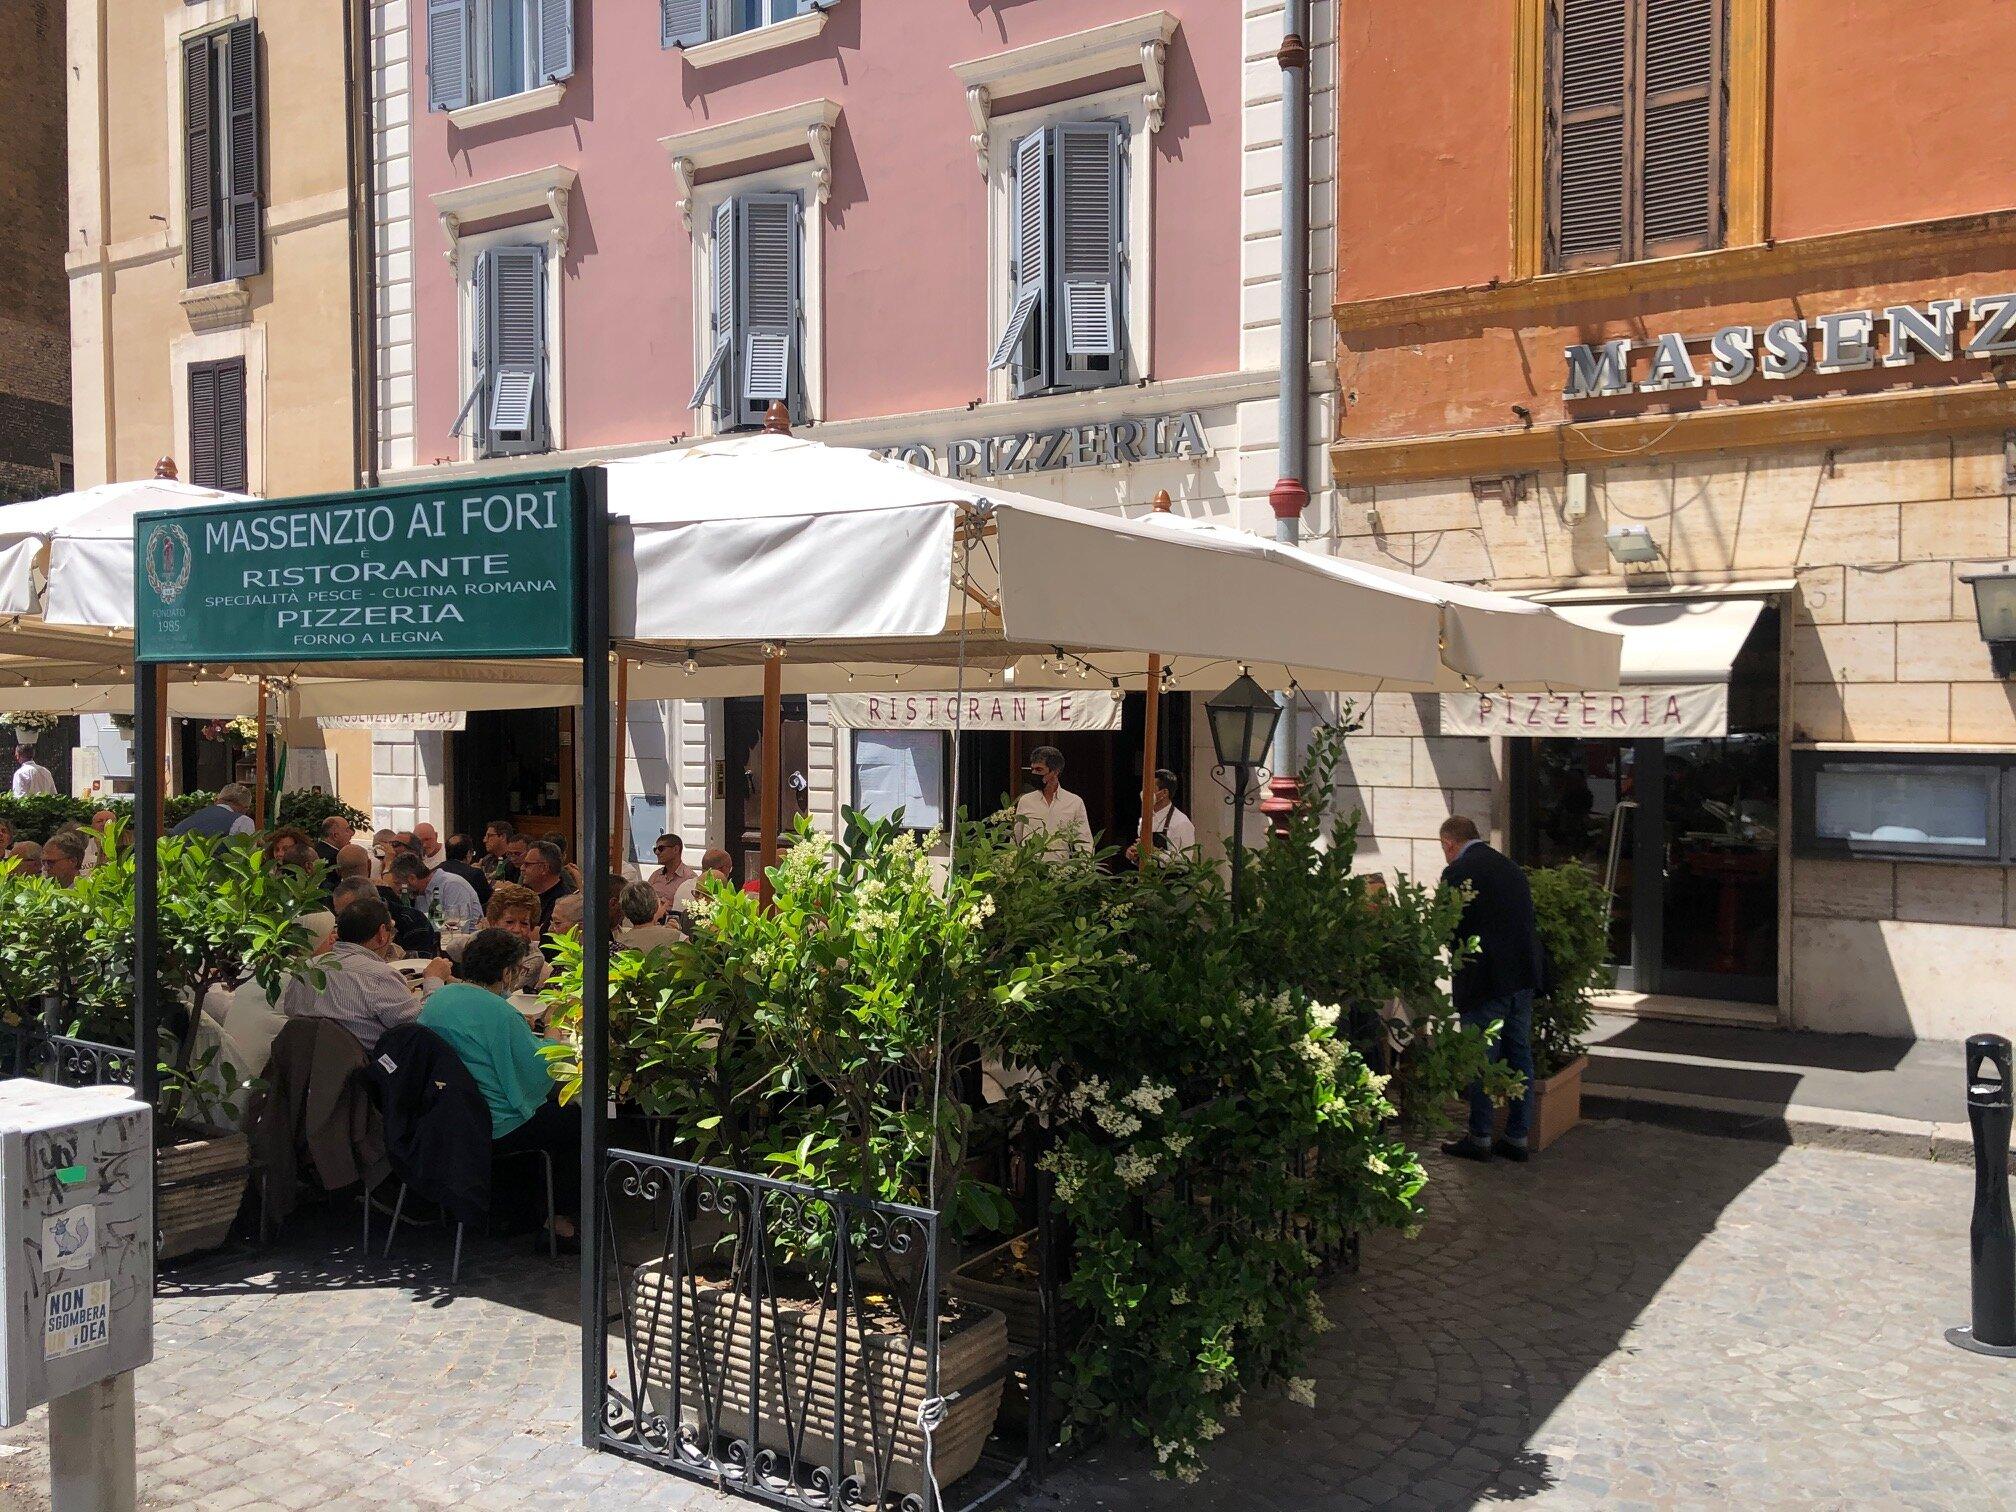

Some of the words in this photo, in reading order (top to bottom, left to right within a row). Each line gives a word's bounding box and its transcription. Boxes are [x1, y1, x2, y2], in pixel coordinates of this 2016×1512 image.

[946, 411, 1210, 480] PIZZERIA
[205, 505, 395, 554] MASSENZIO
[407, 500, 447, 539] AI
[461, 490, 558, 535] FORI
[360, 546, 370, 559] È
[242, 553, 510, 588] RISTORANTE
[205, 589, 300, 607] SPECIALITÀ
[307, 589, 363, 602] PESCE
[382, 584, 458, 599] CUCINA
[464, 579, 557, 596] ROMANA
[152, 608, 186, 619] FONDATO
[158, 619, 181, 633] 1985
[277, 603, 465, 629] PIZZERIA
[293, 632, 356, 646] FORNO
[360, 632, 374, 644] A
[380, 630, 445, 643] LEGNA
[868, 696, 1073, 722] RISTORANTE
[1479, 694, 1682, 725] PIZZERIA
[50, 1288, 84, 1316] NON
[48, 1303, 106, 1332] SGOMBERA
